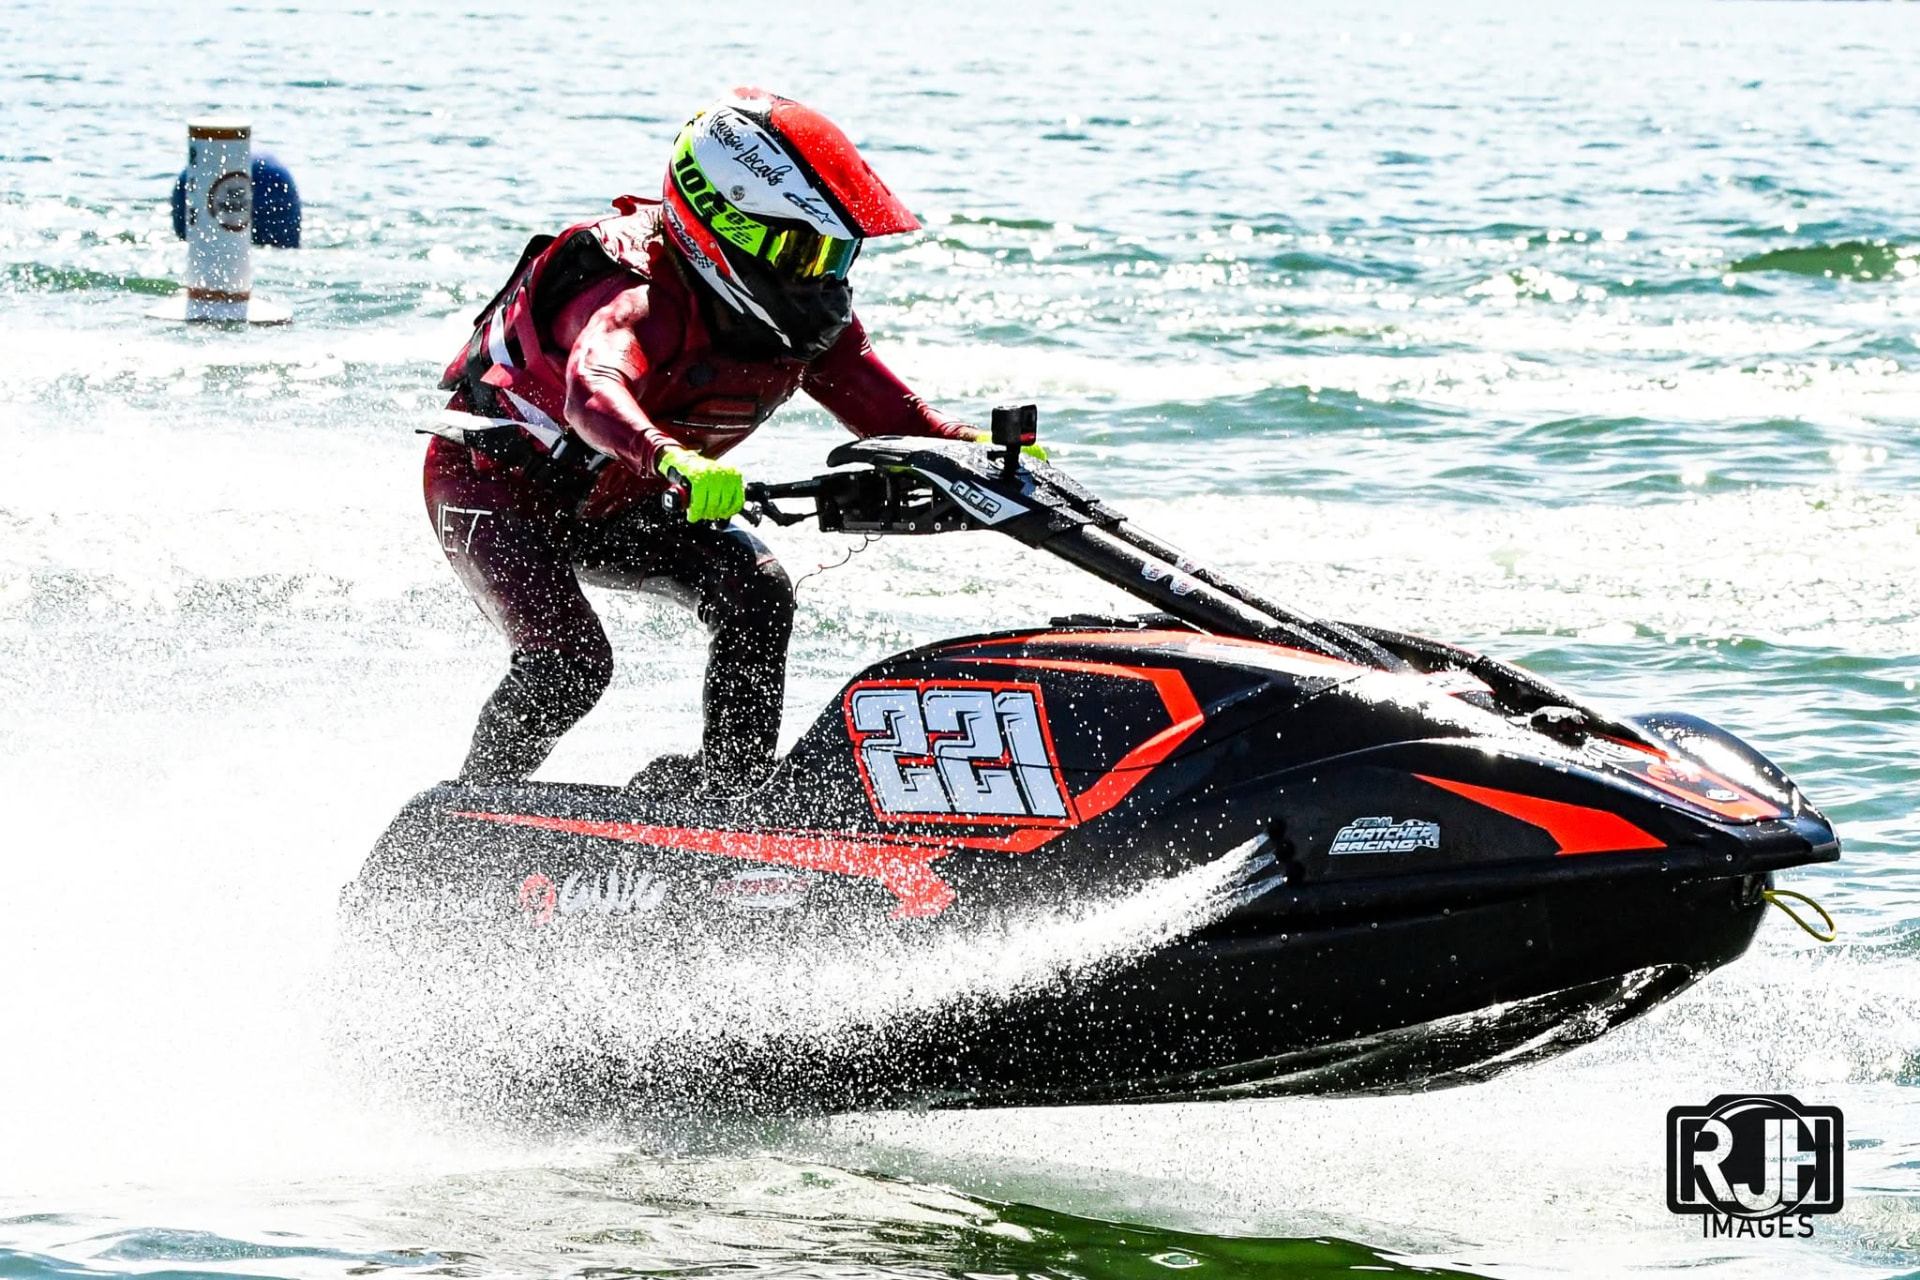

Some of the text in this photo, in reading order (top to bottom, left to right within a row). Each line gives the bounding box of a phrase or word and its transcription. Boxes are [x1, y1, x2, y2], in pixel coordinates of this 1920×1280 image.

[732, 144, 793, 187] Locals
[851, 689, 1067, 818] 221
[1354, 818, 1391, 828] TEAM
[1333, 840, 1416, 852] RACING
